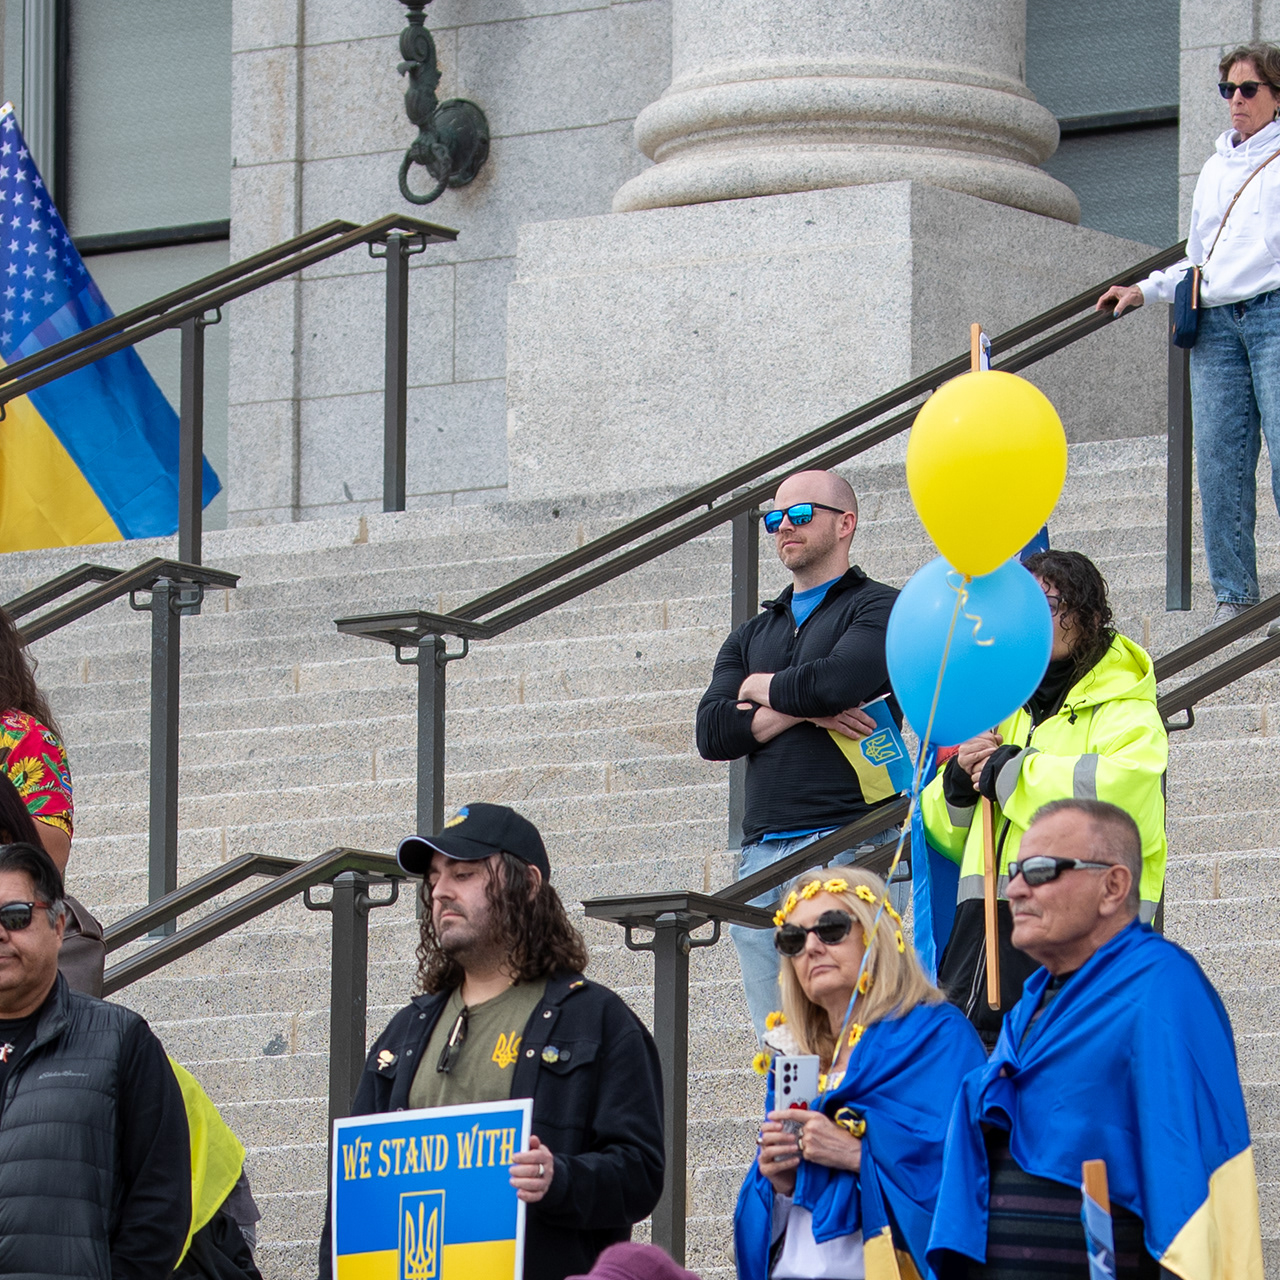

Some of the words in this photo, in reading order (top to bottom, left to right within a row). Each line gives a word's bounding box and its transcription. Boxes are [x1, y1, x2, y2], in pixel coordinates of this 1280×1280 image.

[342, 1135, 372, 1181] WE
[378, 1134, 449, 1177] STAND
[457, 1123, 516, 1170] WITH
